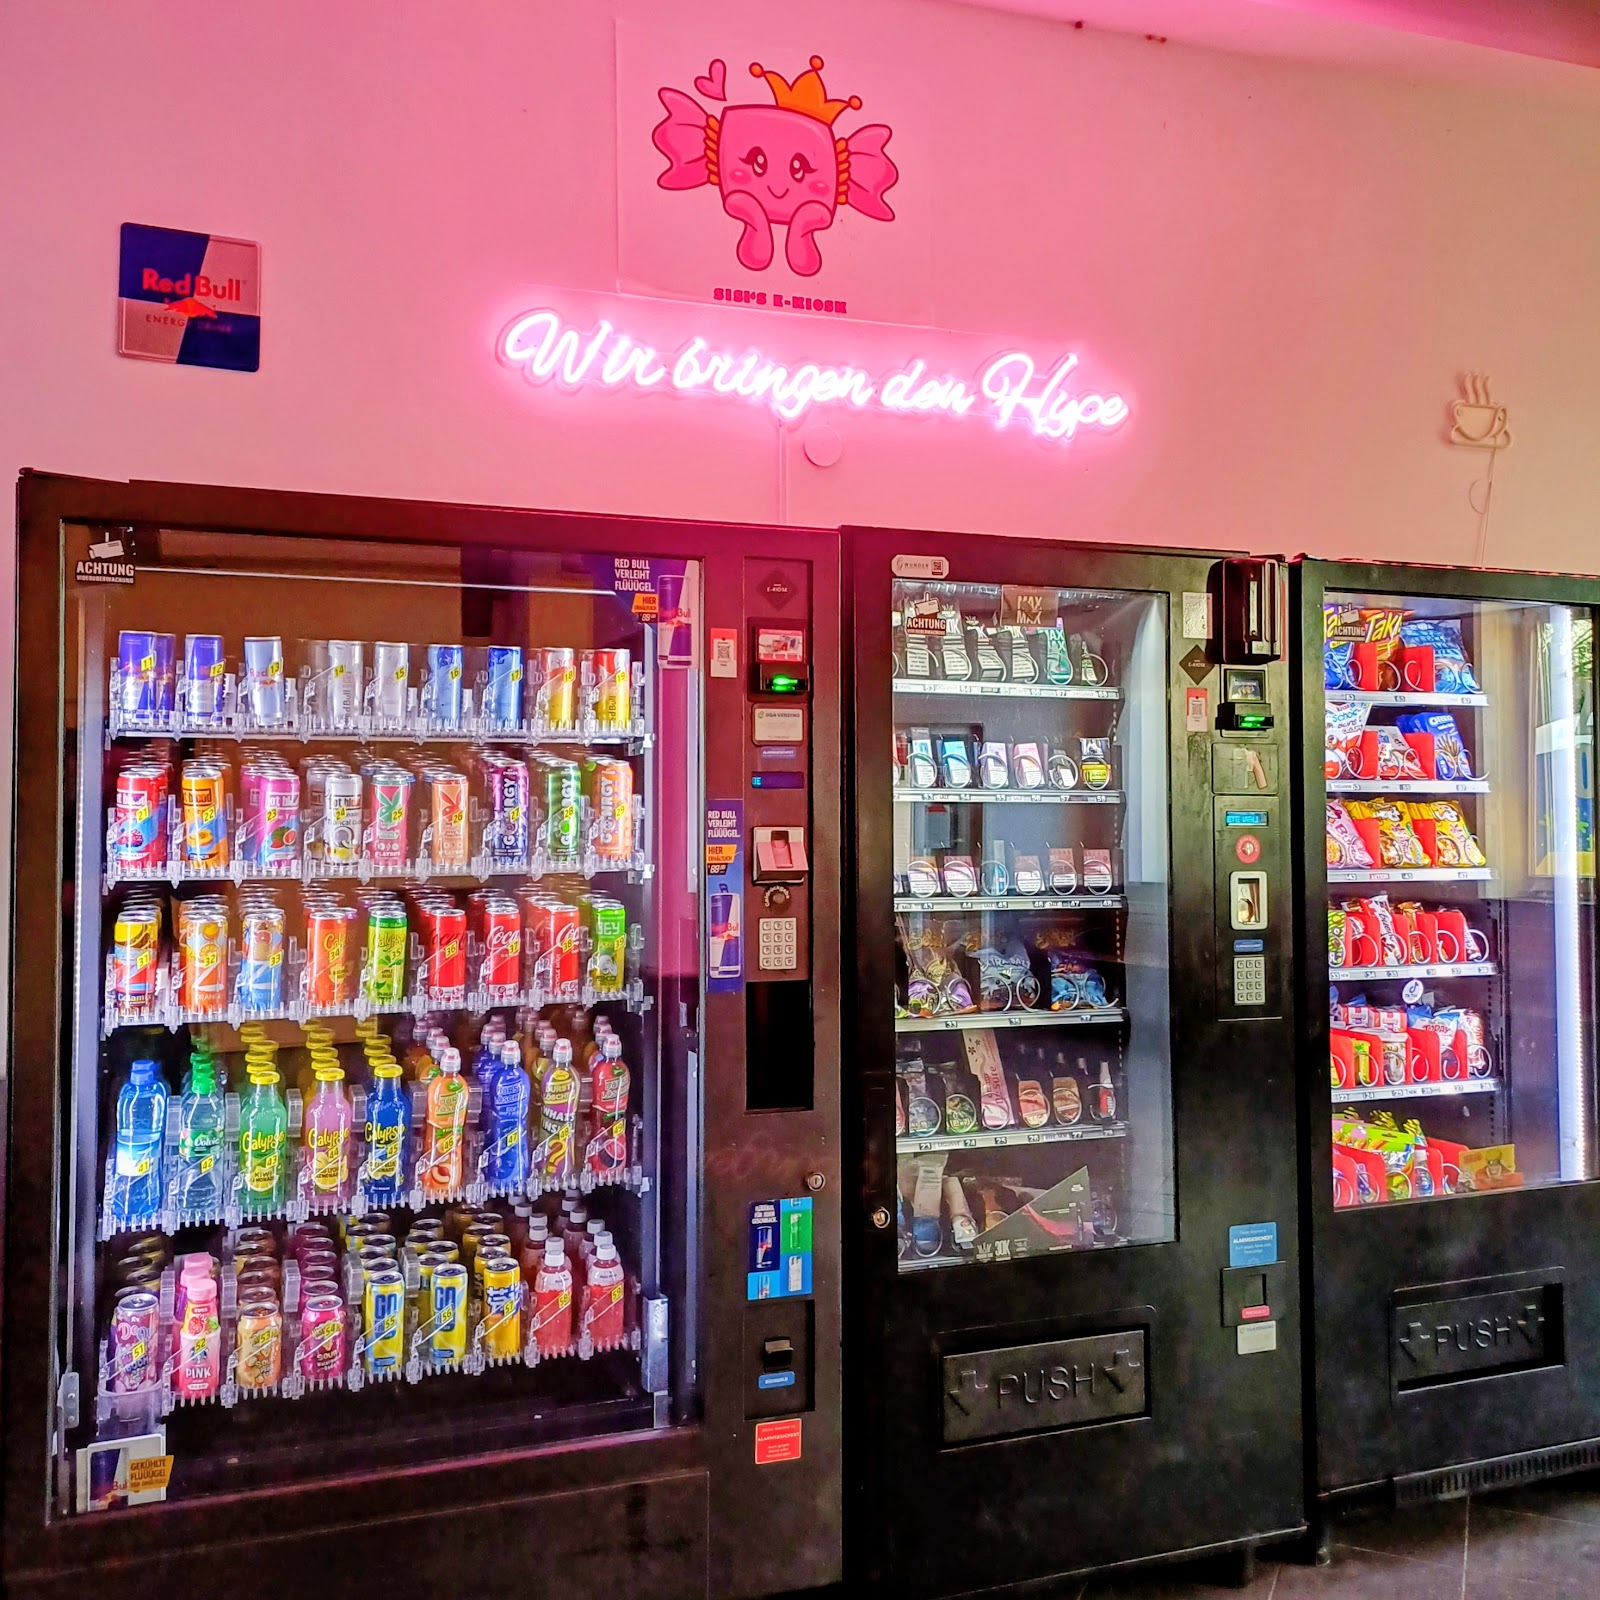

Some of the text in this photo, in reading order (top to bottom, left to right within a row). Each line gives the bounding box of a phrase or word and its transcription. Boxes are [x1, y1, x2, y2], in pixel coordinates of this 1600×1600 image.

[142, 268, 241, 302] Red Bull
[504, 311, 1130, 438] Wir bringen den Hype
[76, 561, 135, 577] ACHTUNG
[614, 558, 651, 570] RED BULL
[615, 569, 651, 580] VERLEIHT
[642, 596, 657, 606] HIER
[907, 617, 946, 630] ACHTUNG
[1334, 626, 1366, 636] ACHTUNG
[142, 656, 153, 668] 11
[212, 664, 223, 675] 12
[269, 663, 281, 675] 13
[334, 666, 345, 677] 14
[395, 668, 406, 679] 15
[450, 668, 460, 678] 16
[510, 669, 521, 680] 17
[564, 671, 574, 681] 18
[616, 671, 627, 682] 19
[138, 808, 148, 821] 21
[203, 808, 215, 822] 22
[266, 808, 278, 821] 23
[335, 808, 346, 821] 24
[392, 808, 403, 821] 25
[453, 810, 464, 823] 26
[510, 808, 520, 820] 27
[564, 807, 574, 819] 28
[615, 806, 625, 817] 29
[707, 810, 737, 820] RED BULL
[707, 820, 737, 829] VERLEIHT
[708, 846, 723, 855] HIER
[509, 941, 519, 954] 37
[563, 939, 573, 951] 38
[615, 937, 625, 949] 39
[330, 949, 340, 961] 34
[391, 949, 401, 961] 35
[446, 943, 456, 957] 36
[138, 955, 149, 967] 31
[204, 955, 216, 966] 32
[270, 955, 281, 966] 33
[559, 1128, 570, 1140] 48
[613, 1123, 624, 1135] 49
[443, 1137, 455, 1151] 46
[507, 1132, 518, 1145] 47
[329, 1148, 340, 1160] 44
[387, 1145, 399, 1156] 45
[202, 1158, 213, 1170] 42
[266, 1155, 277, 1167] 43
[138, 1162, 149, 1173] 41
[611, 1287, 622, 1299] 59
[558, 1293, 569, 1306] 58
[504, 1302, 514, 1314] 57
[442, 1309, 452, 1321] 56
[384, 1317, 396, 1329] 55
[325, 1324, 336, 1337] 54
[1436, 1315, 1513, 1355] PUSH
[260, 1331, 271, 1343] 53
[195, 1338, 206, 1351] 52
[133, 1345, 145, 1358] 51
[185, 1367, 212, 1379] PINK
[998, 1362, 1096, 1409] PUSH
